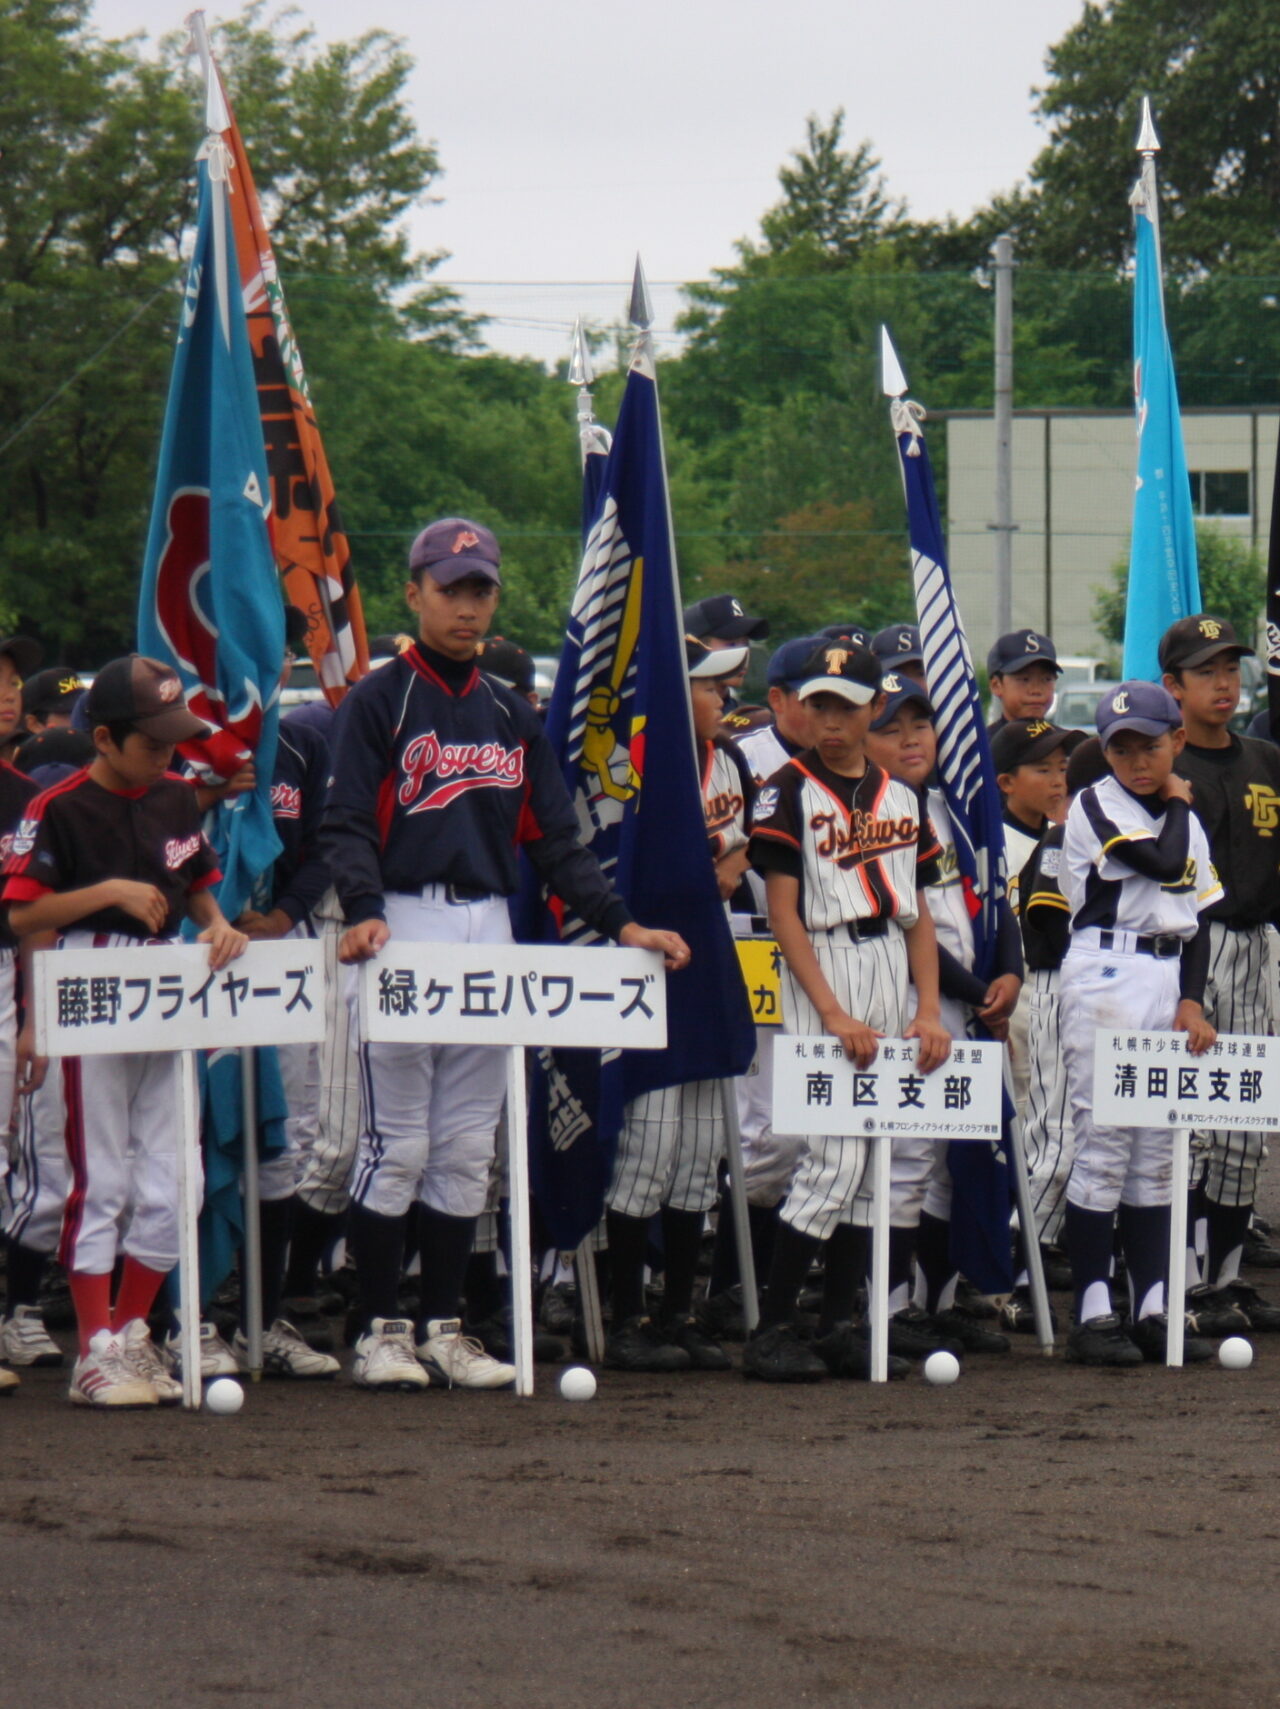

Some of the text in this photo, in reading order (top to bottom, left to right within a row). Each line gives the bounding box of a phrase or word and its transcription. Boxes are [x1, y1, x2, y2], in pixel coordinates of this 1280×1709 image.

[897, 632, 913, 652] S
[1024, 633, 1041, 653] S
[825, 647, 848, 675] T
[56, 965, 314, 1028] 藤野フライヤーズ
[377, 966, 656, 1021] 緑ヶ丘パワーズ
[794, 1042, 983, 1065] 札幌市軟式連盟
[1112, 1035, 1267, 1058] 札幌市少年野球連盟
[805, 1070, 973, 1110] 南区支部
[1114, 1063, 1263, 1104] 清田区支部
